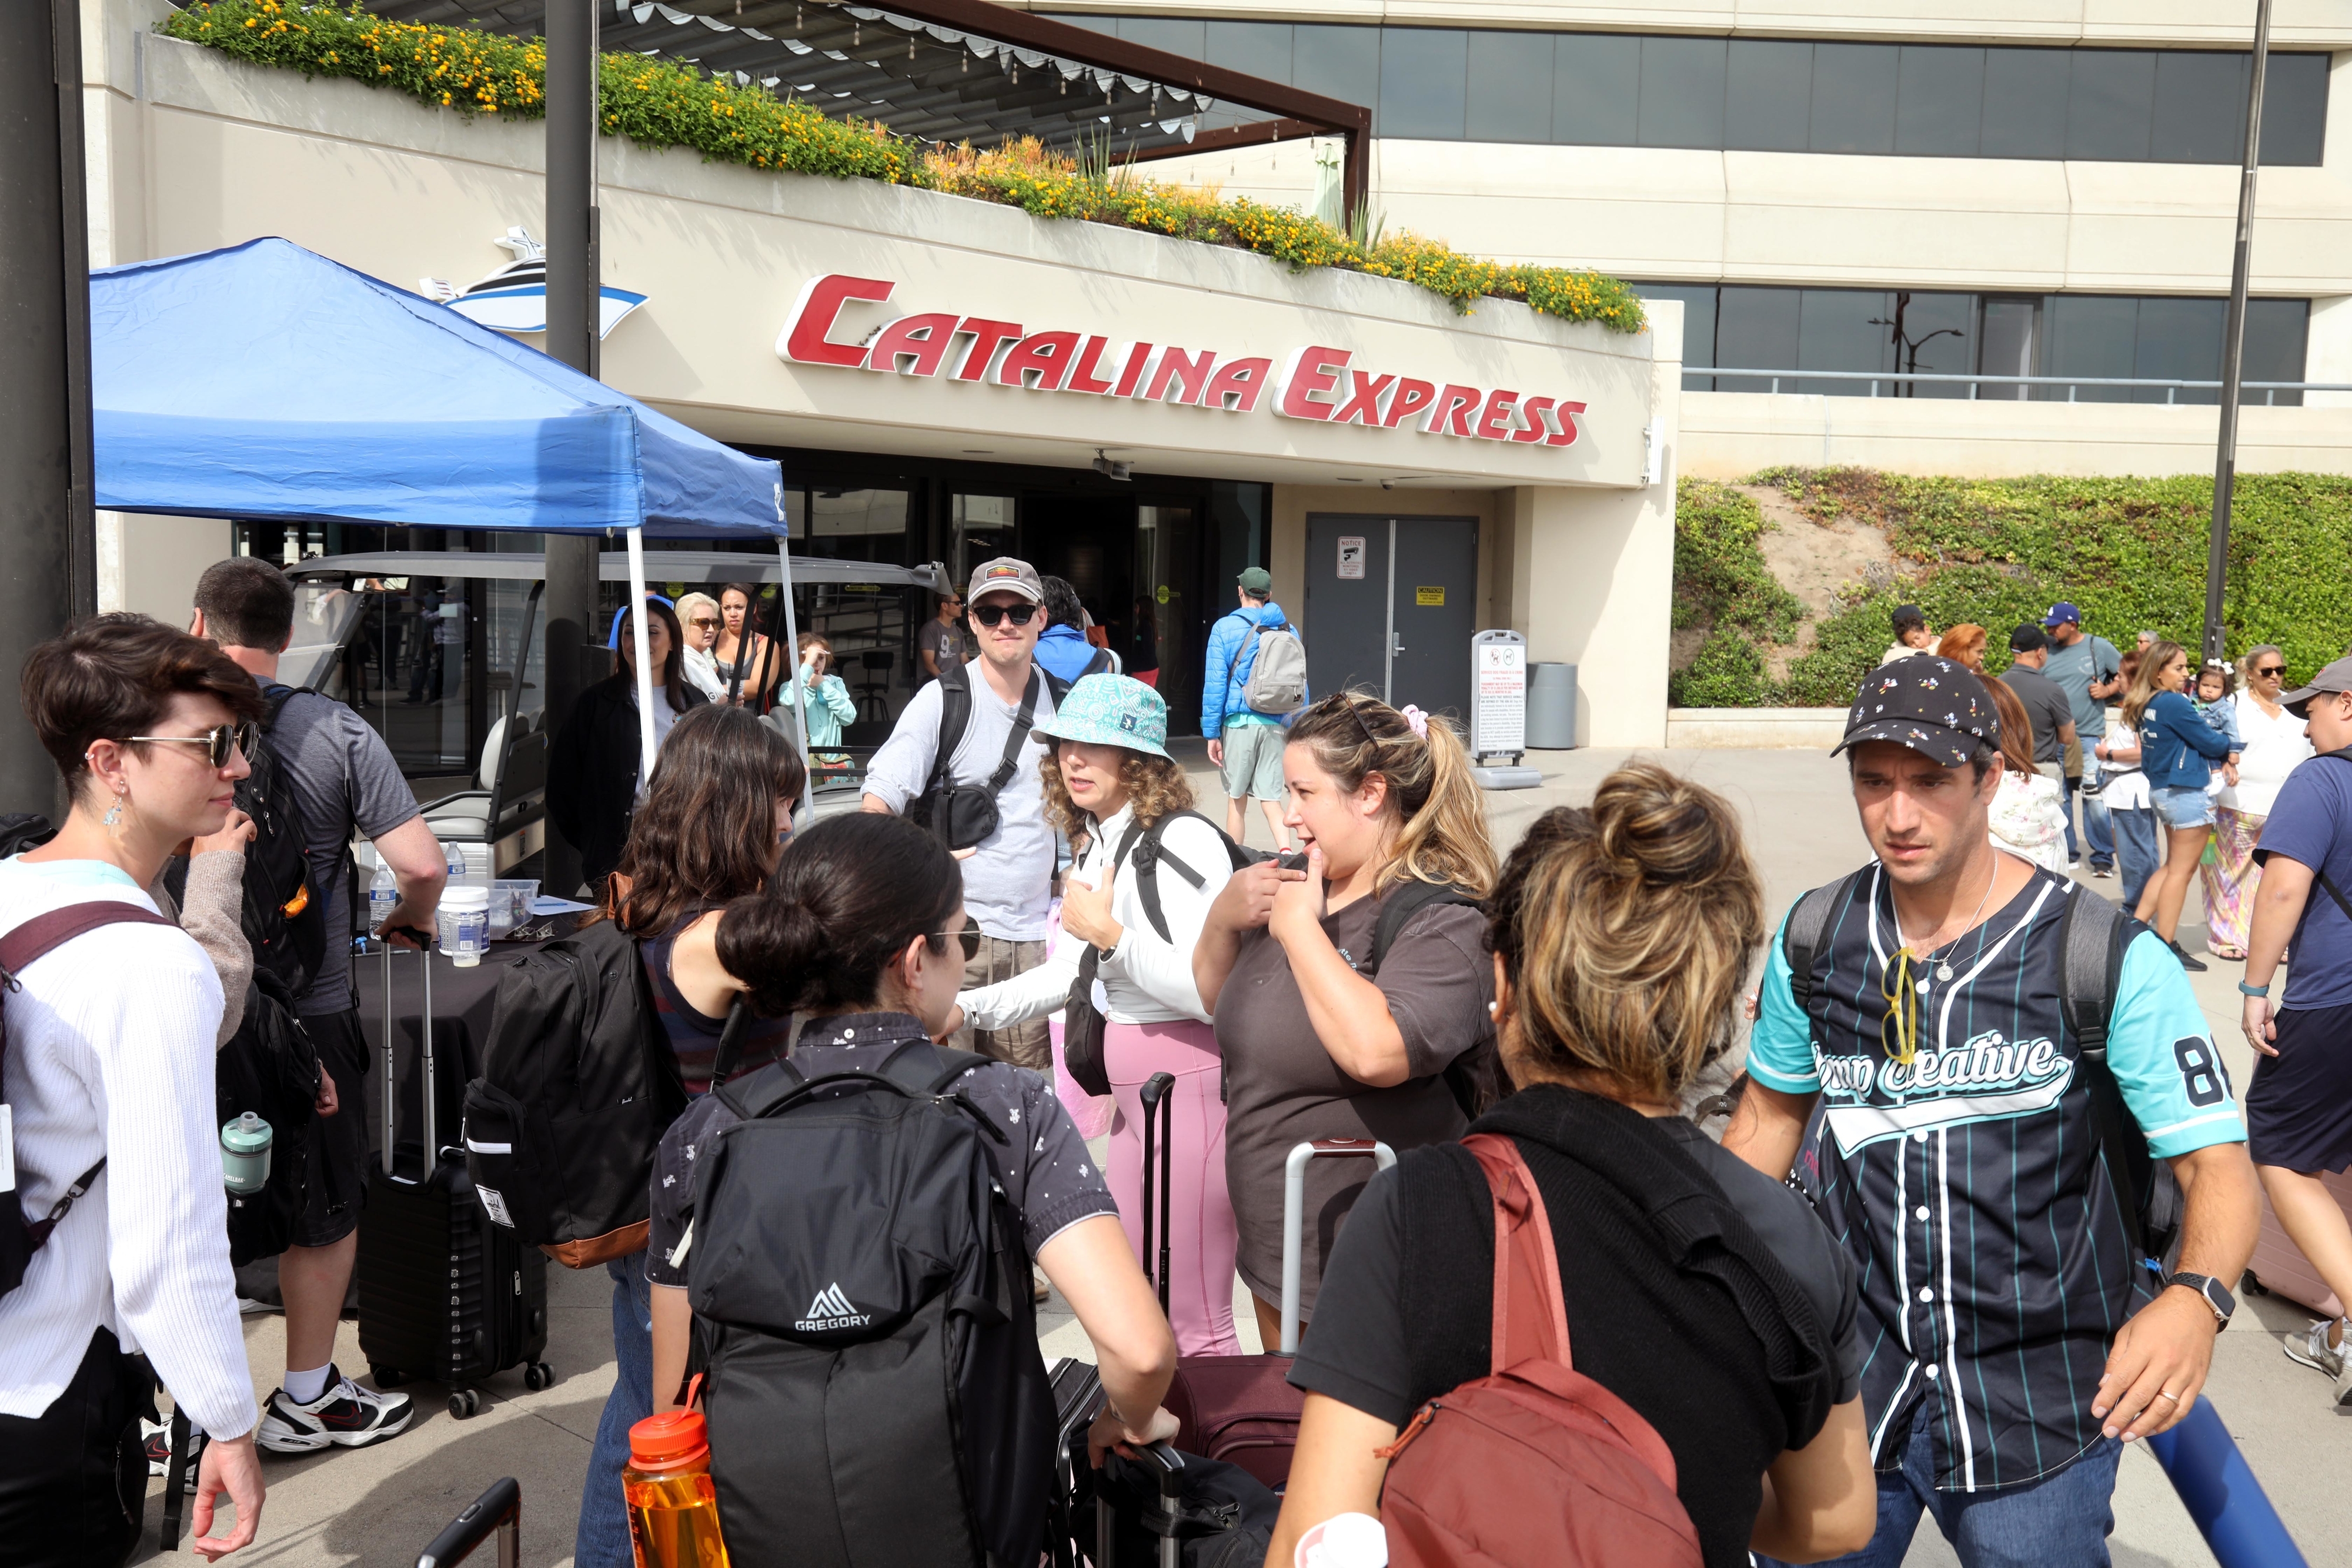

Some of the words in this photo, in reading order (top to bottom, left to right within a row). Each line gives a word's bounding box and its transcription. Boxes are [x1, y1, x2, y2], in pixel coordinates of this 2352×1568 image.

[777, 274, 1273, 413] CATALINA
[1274, 346, 1588, 448] EXPRESS
[795, 1315, 871, 1332] GREGORY
